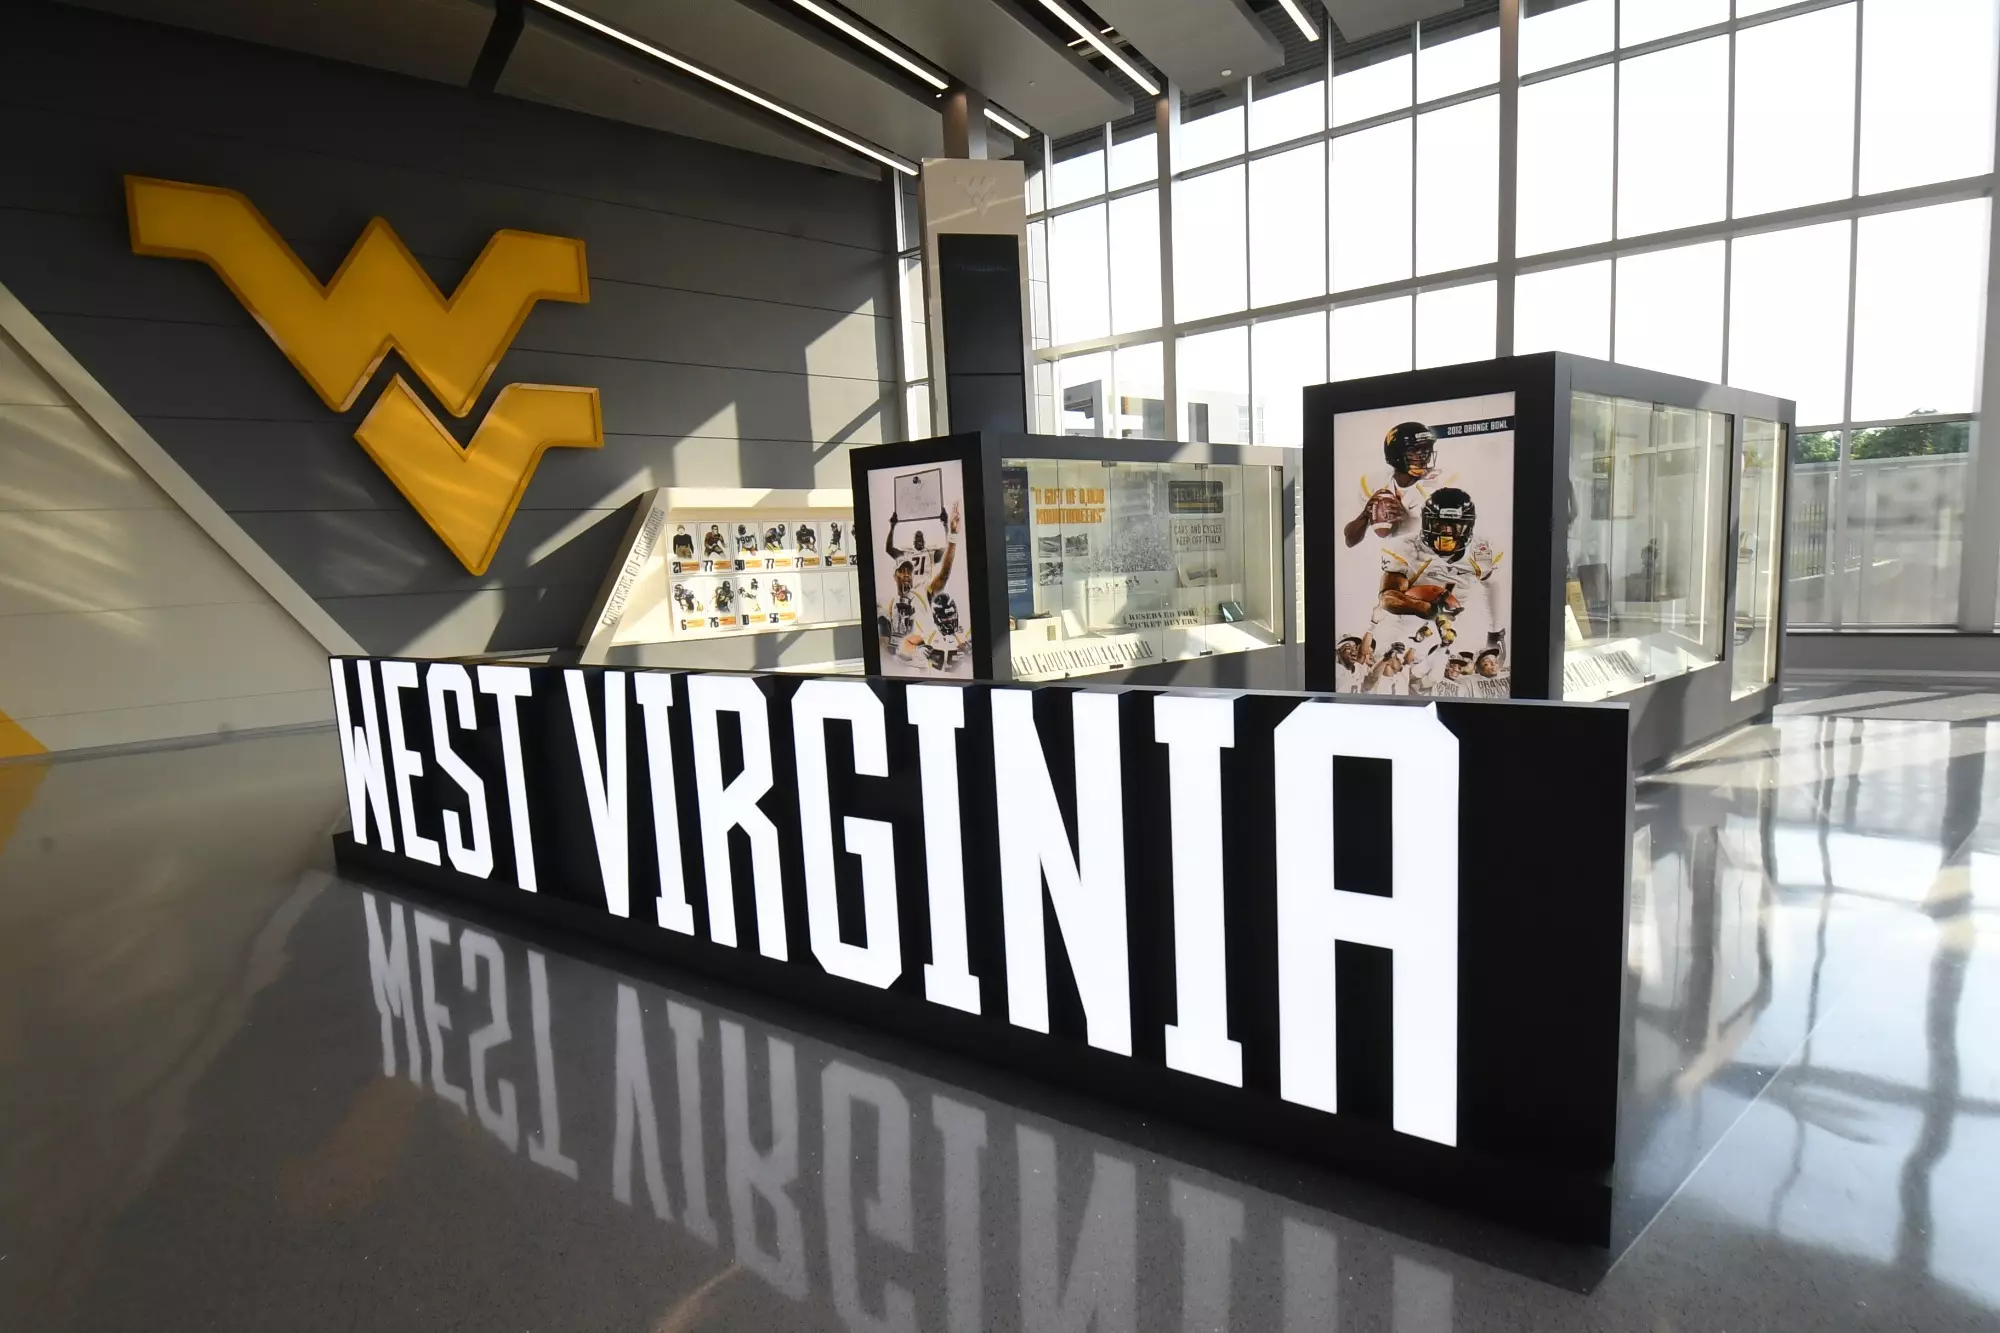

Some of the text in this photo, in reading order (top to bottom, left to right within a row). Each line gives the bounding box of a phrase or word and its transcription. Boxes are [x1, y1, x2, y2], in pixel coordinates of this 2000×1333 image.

[1448, 420, 1507, 435] 2012 ORANGE BOWL
[1045, 488, 1063, 505] GIFT
[1066, 487, 1076, 504] OF
[1174, 524, 1222, 535] CARS AND CYCLES
[1176, 535, 1221, 546] KEEP OFF TRACK
[673, 561, 682, 573] 21
[703, 560, 713, 572] 77
[734, 559, 745, 570] 90
[765, 558, 775, 570] 77
[795, 556, 804, 568] 77
[824, 555, 832, 567] 16
[912, 556, 925, 575] 21
[741, 614, 750, 625] 10
[1129, 608, 1195, 621] RESERVED FOR
[681, 619, 687, 630] 6
[708, 617, 719, 628] 76
[1128, 618, 1198, 629] TICKET BUYERS
[330, 658, 1460, 1148] WEST VIRGINIA
